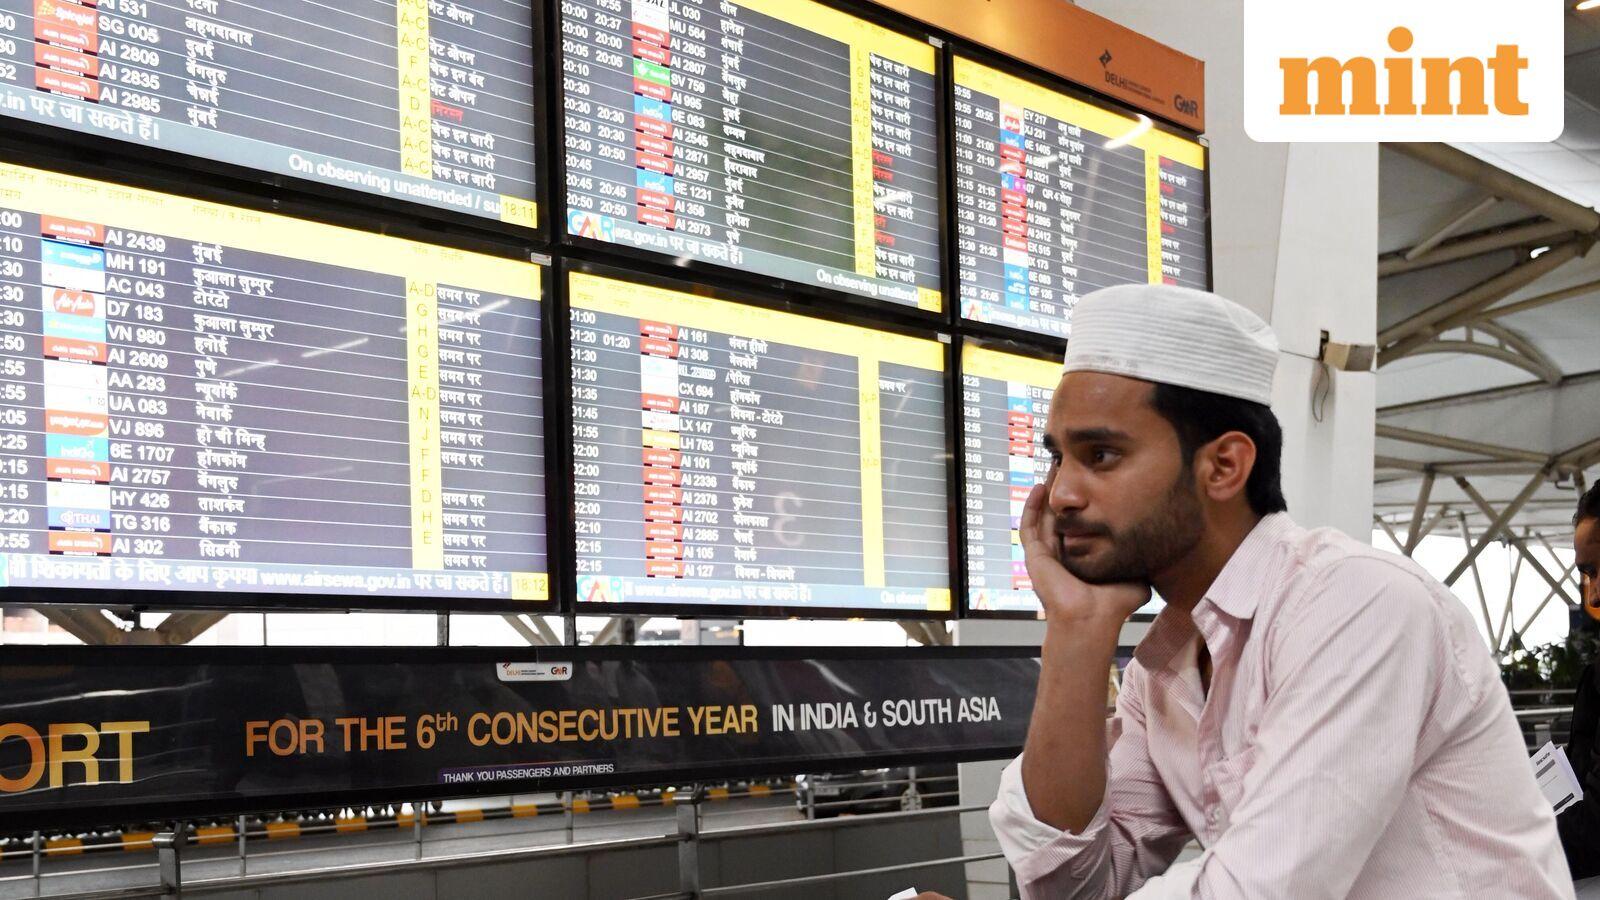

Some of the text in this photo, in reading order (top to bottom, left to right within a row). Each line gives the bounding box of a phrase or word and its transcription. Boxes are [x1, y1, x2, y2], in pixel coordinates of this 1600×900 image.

[562, 2, 700, 30] 20:00 20:37 JL 030
[98, 15, 160, 43] SG 005
[562, 20, 588, 39] 20:00
[596, 31, 622, 49] 20:00
[670, 18, 687, 34] MU
[98, 40, 160, 66] AI 2809
[563, 40, 589, 58] 20:05
[596, 51, 623, 68] 20:05
[670, 38, 681, 50] AI
[99, 64, 160, 89] AI 2835
[563, 58, 589, 76] 20:10
[670, 56, 681, 68] AI
[564, 77, 590, 96] 20:30
[671, 75, 686, 88] SV
[100, 88, 160, 113] AI 2985
[564, 97, 590, 114] 20:30
[598, 107, 624, 124] 20:30
[671, 91, 682, 104] AI
[59, 102, 82, 123] जा
[565, 115, 591, 133] 20:30
[598, 126, 625, 142] 20:30
[565, 134, 591, 152] 20:30
[599, 145, 626, 161] 20:50
[672, 127, 683, 140] AI
[566, 154, 592, 171] 20:45
[673, 146, 684, 158] AI
[288, 154, 472, 208] On observing unattended
[566, 172, 592, 190] 20:45
[600, 182, 627, 198] 20:45
[567, 192, 593, 209] 20:50
[600, 200, 627, 216] 20:50
[675, 200, 685, 212] AI
[675, 218, 686, 231] AI
[106, 230, 166, 253] AI 2439
[106, 252, 134, 271] MH
[139, 257, 166, 276] 191
[106, 276, 164, 298] AC 043
[816, 268, 832, 285] On
[107, 301, 130, 316] D7
[134, 304, 163, 321] 183
[107, 324, 133, 340] VN
[136, 326, 166, 345] 980
[678, 328, 689, 340] AI
[603, 334, 630, 349] 01:20
[679, 346, 689, 358] AI
[108, 347, 126, 363] AI
[129, 350, 168, 368] 2609
[108, 371, 166, 392] AA 293
[108, 394, 167, 415] UA 083
[679, 401, 690, 413] AI
[109, 419, 130, 435] VJ
[134, 421, 164, 438] 896
[680, 418, 713, 434] LX 147
[110, 442, 174, 462] 6E 1707
[680, 435, 695, 449] LH
[681, 455, 710, 469] AI 101
[111, 467, 128, 483] AI
[132, 469, 170, 485] 2757
[681, 473, 692, 486] AI
[112, 490, 170, 508] HY 426
[111, 514, 171, 532] TG 316
[682, 511, 693, 523] AI
[113, 537, 131, 553] AI
[133, 539, 164, 555] 302
[684, 565, 714, 578] AI 127
[246, 696, 1002, 757] FOR THE 6th CONSECUTIVE YEAR IN INDIA & SOUTH ASIA
[0, 720, 150, 792] ORT
[444, 764, 614, 783] THANK YOU PASSENGERS AND PARTNERS
